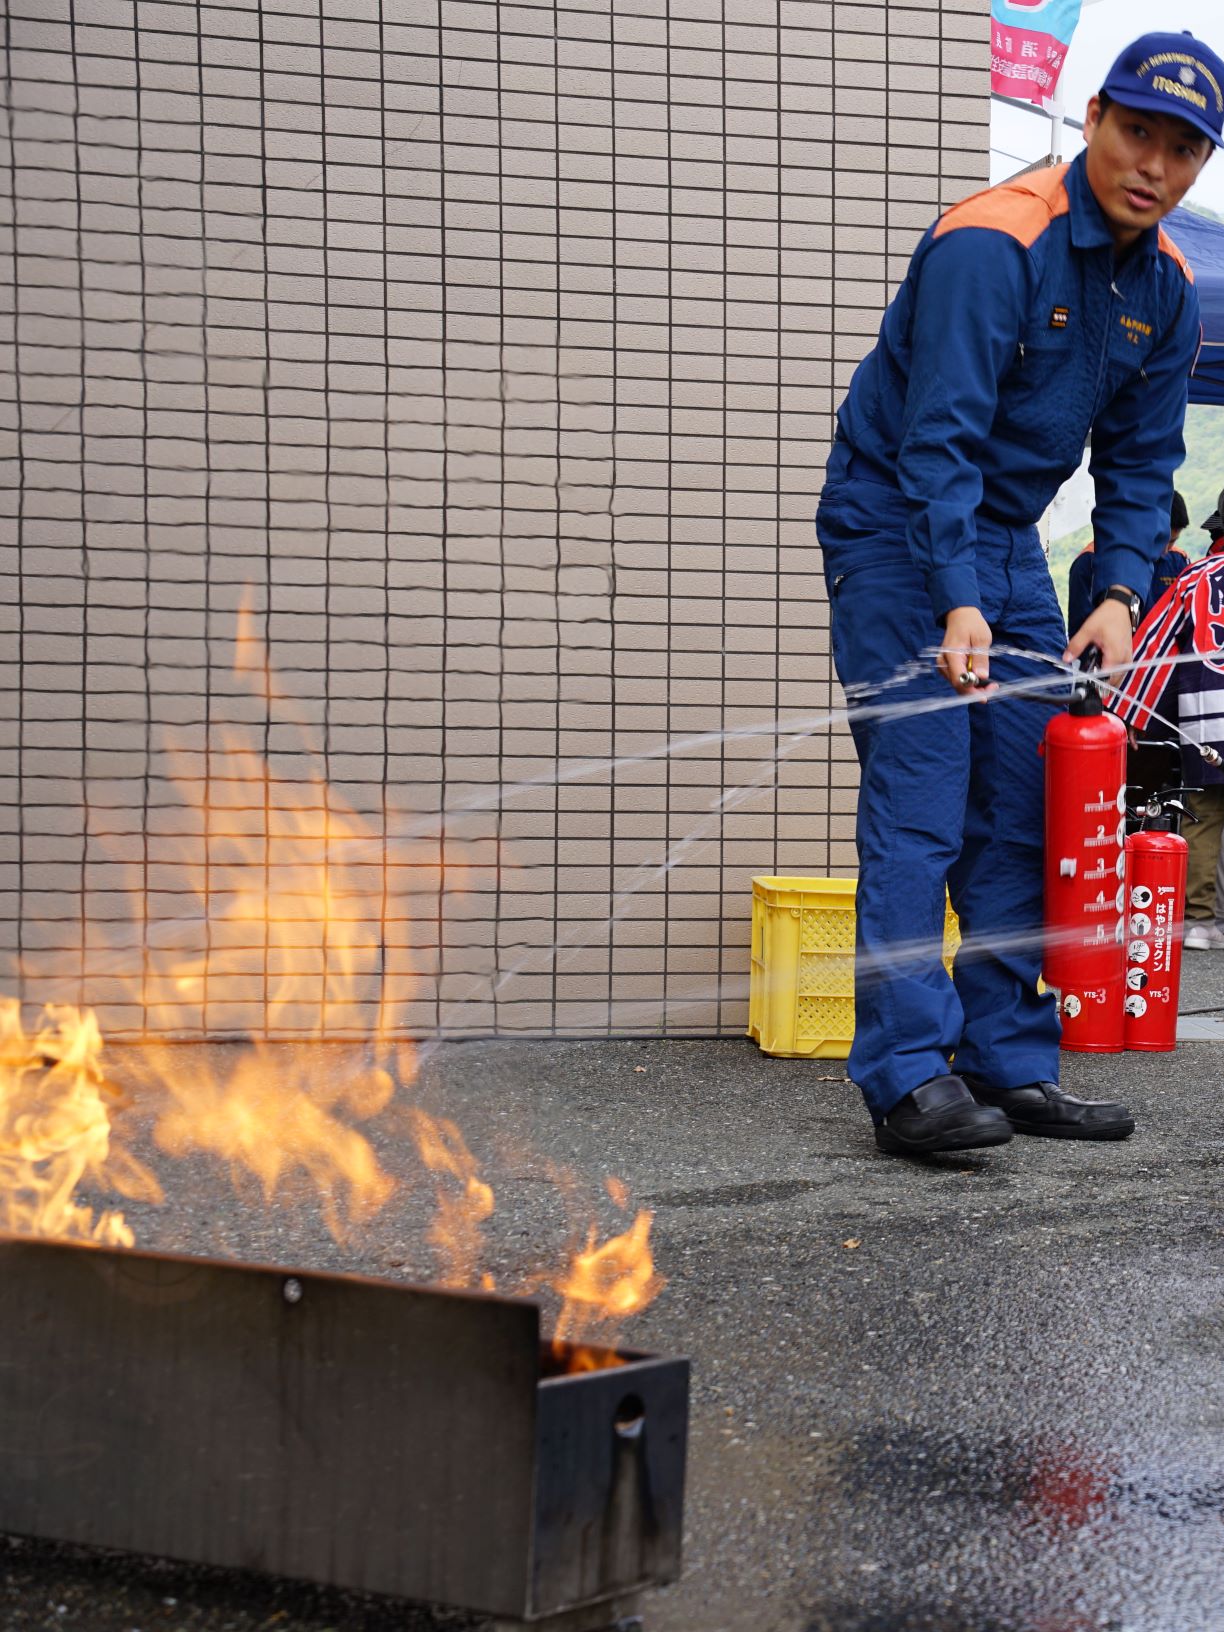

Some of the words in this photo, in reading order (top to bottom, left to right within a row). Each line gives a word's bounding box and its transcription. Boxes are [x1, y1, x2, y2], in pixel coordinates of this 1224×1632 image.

[1098, 790, 1104, 805] 1
[1097, 825, 1105, 839] 2
[1096, 858, 1105, 872] 3
[1096, 889, 1105, 904] 4
[1153, 903, 1166, 972] はやわざクン
[1083, 987, 1106, 1004] YTS-3
[1149, 986, 1170, 1003] YTS-3
